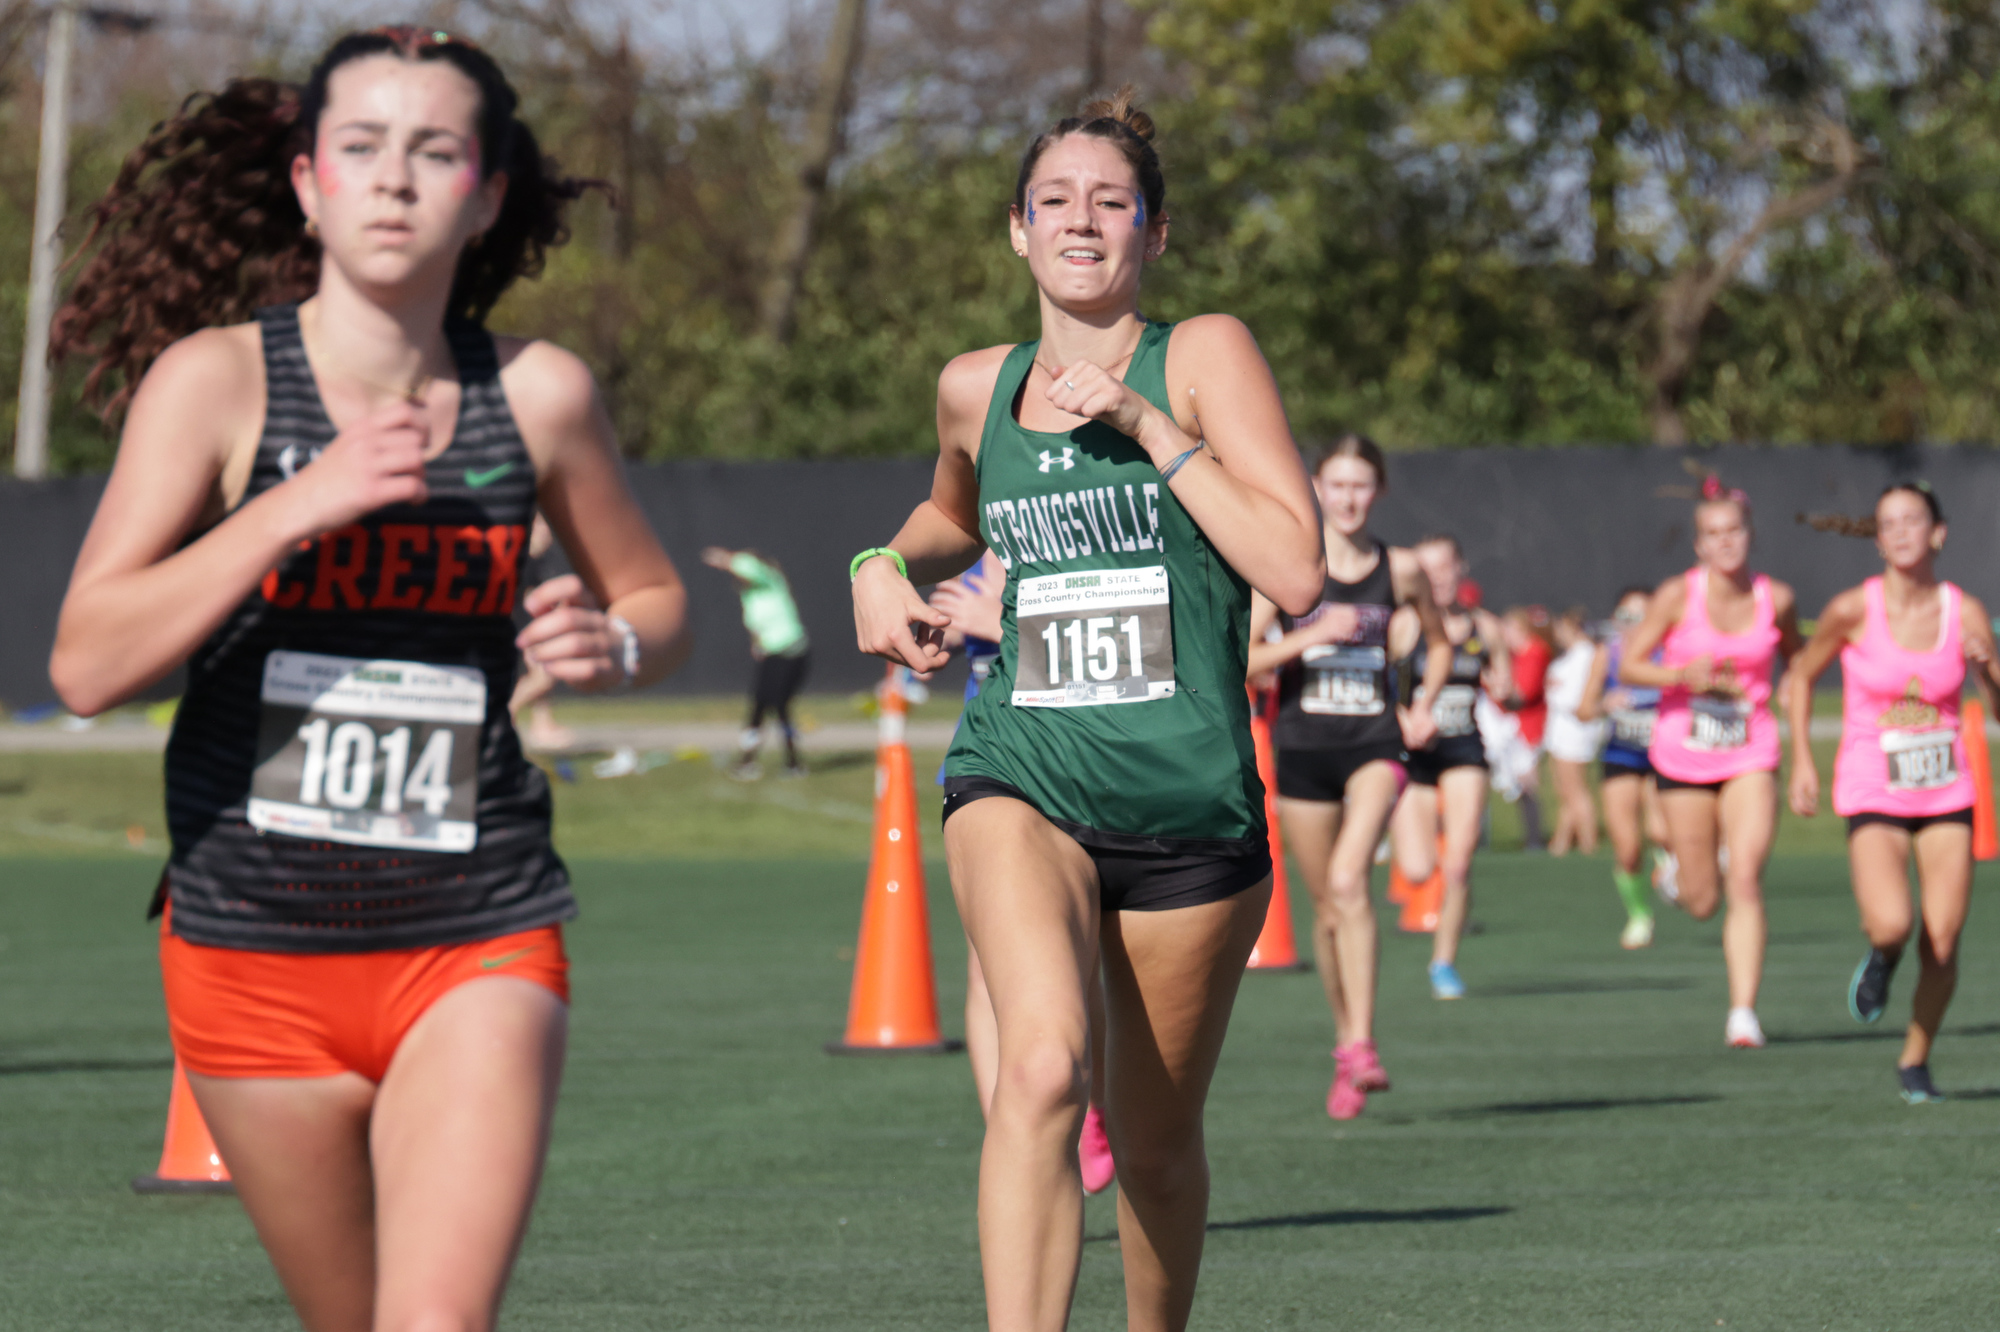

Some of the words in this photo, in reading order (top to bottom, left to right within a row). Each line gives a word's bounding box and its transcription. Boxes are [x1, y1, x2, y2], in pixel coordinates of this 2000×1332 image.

[986, 483, 1164, 569] STRONGSVILLE
[261, 523, 525, 615] CREEK
[1019, 597, 1042, 606] Cross
[1044, 592, 1081, 604] Country
[1084, 586, 1165, 599] Championships
[1037, 581, 1059, 591] 2023
[1065, 575, 1101, 589] OHSAA
[1107, 575, 1141, 585] STATE
[1042, 615, 1143, 684] 1151
[298, 718, 454, 816] 1014
